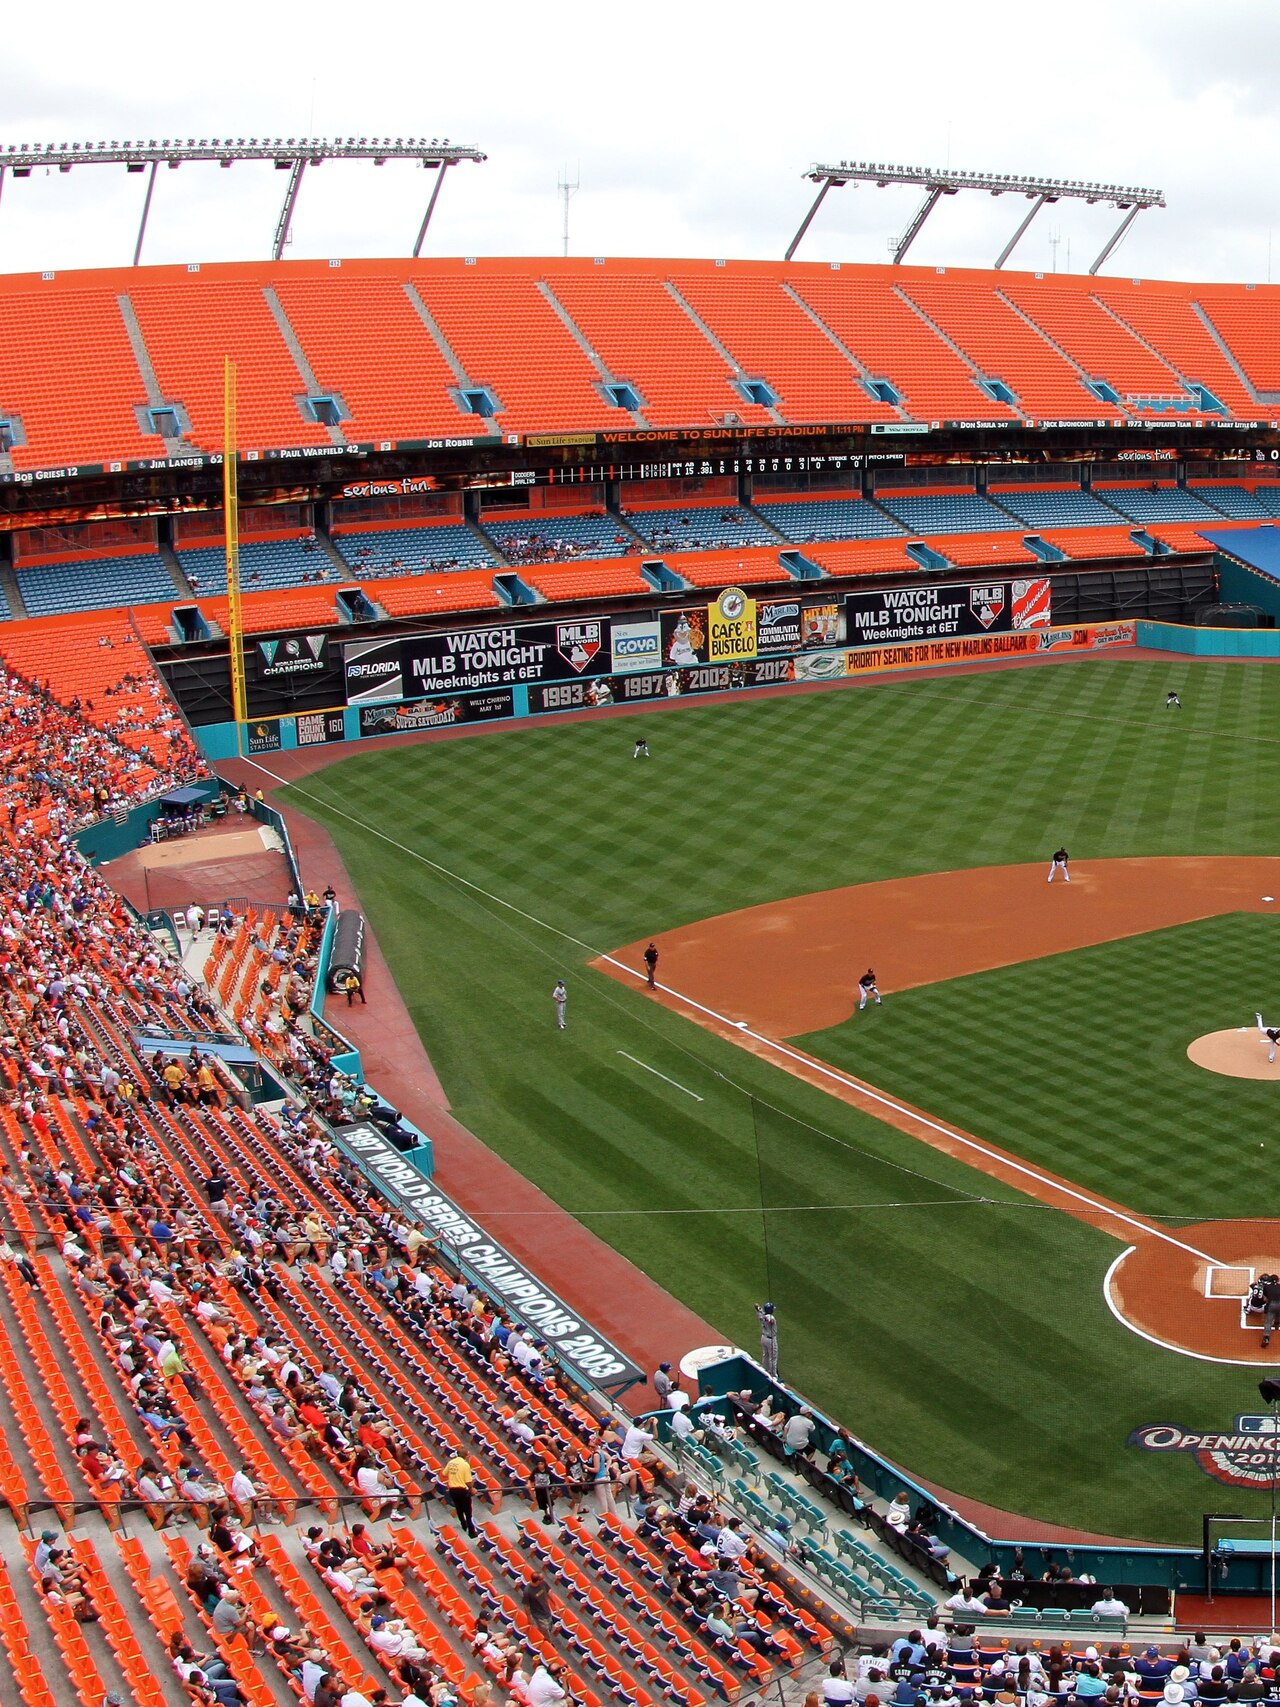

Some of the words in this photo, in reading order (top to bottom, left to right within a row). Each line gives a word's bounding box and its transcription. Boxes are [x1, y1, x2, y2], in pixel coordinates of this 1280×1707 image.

[535, 437, 550, 446] Sun
[550, 436, 567, 445] Life
[602, 430, 679, 443] WELCOME
[681, 430, 700, 440] TO
[702, 429, 732, 439] SUN
[734, 428, 766, 438] LIFE
[767, 426, 827, 437] STADIUM
[853, 425, 864, 433] PM
[280, 449, 301, 458] PAUL
[302, 446, 344, 457] WARFIELD
[346, 444, 359, 454] 42
[427, 439, 443, 448] JOE
[445, 438, 474, 448] ROBBIE
[149, 459, 167, 469] JIM
[168, 457, 203, 468] LANGER
[210, 454, 223, 464] 62
[1117, 450, 1152, 461] serious
[1153, 449, 1173, 460] fun.
[1270, 450, 1279, 460] 0
[14, 472, 33, 482] BOB
[35, 469, 65, 480] GRIESE
[67, 467, 78, 477] 12
[343, 481, 398, 498] serious
[400, 478, 431, 495] fun.
[883, 589, 938, 609] WATCH
[971, 587, 1004, 602] MLB
[1012, 579, 1051, 628] Budweiser
[759, 603, 800, 626] MARLINS
[803, 607, 821, 620] HIT
[822, 604, 839, 616] ME
[855, 611, 891, 629] MLB
[559, 623, 599, 641] MLB
[758, 632, 801, 644] FOUNDATION
[759, 625, 800, 636] COMMUNITY
[862, 624, 926, 641] Weeknights
[926, 625, 937, 635] at
[938, 621, 959, 633] 6ET
[446, 629, 516, 653] WATCH
[559, 637, 599, 646] NETWORK
[616, 638, 657, 655] GOYA
[711, 636, 755, 657] BUSTELO
[848, 650, 882, 670] PRIORITY
[883, 647, 913, 666] SEATING
[914, 645, 929, 661] FOR
[930, 644, 944, 659] THE
[945, 642, 961, 658] NEW
[962, 639, 993, 657] MARLINS
[993, 634, 1028, 654] BALLPARK
[1029, 636, 1037, 650] @
[1072, 629, 1088, 645] .COM
[263, 661, 324, 676] CHAMPIONS
[361, 660, 401, 676] FLORIDA
[412, 656, 456, 677] MLB
[755, 660, 790, 682] 2012
[421, 671, 499, 691] Weeknights
[502, 670, 516, 682] at
[518, 664, 543, 680] 6ET
[689, 667, 730, 690] 2003
[623, 674, 664, 698] 1997
[469, 697, 487, 707] WILLY
[487, 695, 511, 705] CHIRINO
[541, 685, 584, 707] 1993
[362, 705, 398, 726] MARLINS
[479, 705, 493, 713] MAY
[298, 714, 325, 726] GAME
[329, 718, 343, 733] 160
[396, 714, 418, 729] SUPER
[417, 708, 457, 728] SATURDAYS
[298, 723, 326, 735] COUNT
[249, 738, 264, 746] Sun
[264, 735, 279, 744] Life
[249, 742, 280, 750] STADIUM
[299, 732, 326, 744] DOWN
[341, 1125, 387, 1152] 1997
[366, 1150, 431, 1197] WORLD
[410, 1195, 482, 1247] SERIES
[460, 1245, 580, 1338] CHAMPIONS
[555, 1334, 627, 1379] 2003
